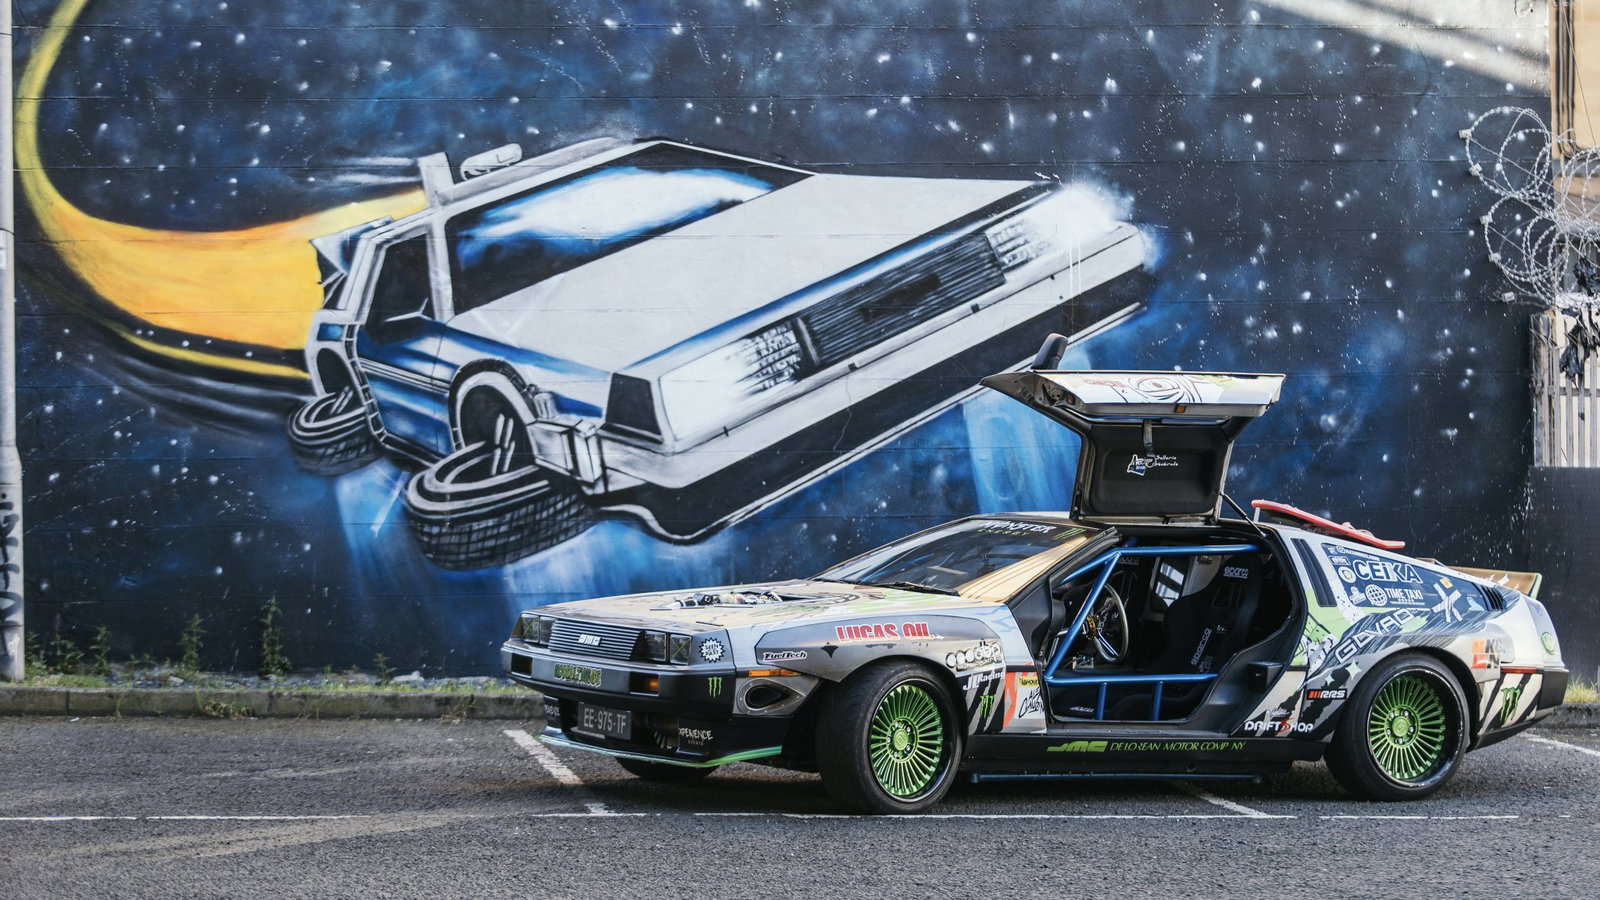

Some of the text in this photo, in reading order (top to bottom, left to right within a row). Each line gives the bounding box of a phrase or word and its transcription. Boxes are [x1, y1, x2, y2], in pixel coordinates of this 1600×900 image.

[1384, 587, 1424, 600] TIME TAXI
[836, 622, 932, 641] LUCAS OIL
[764, 651, 807, 660] FuelTech
[1320, 690, 1346, 699] RRS
[583, 708, 627, 734] EE-975-TF
[1165, 742, 1200, 751] MOTOR
